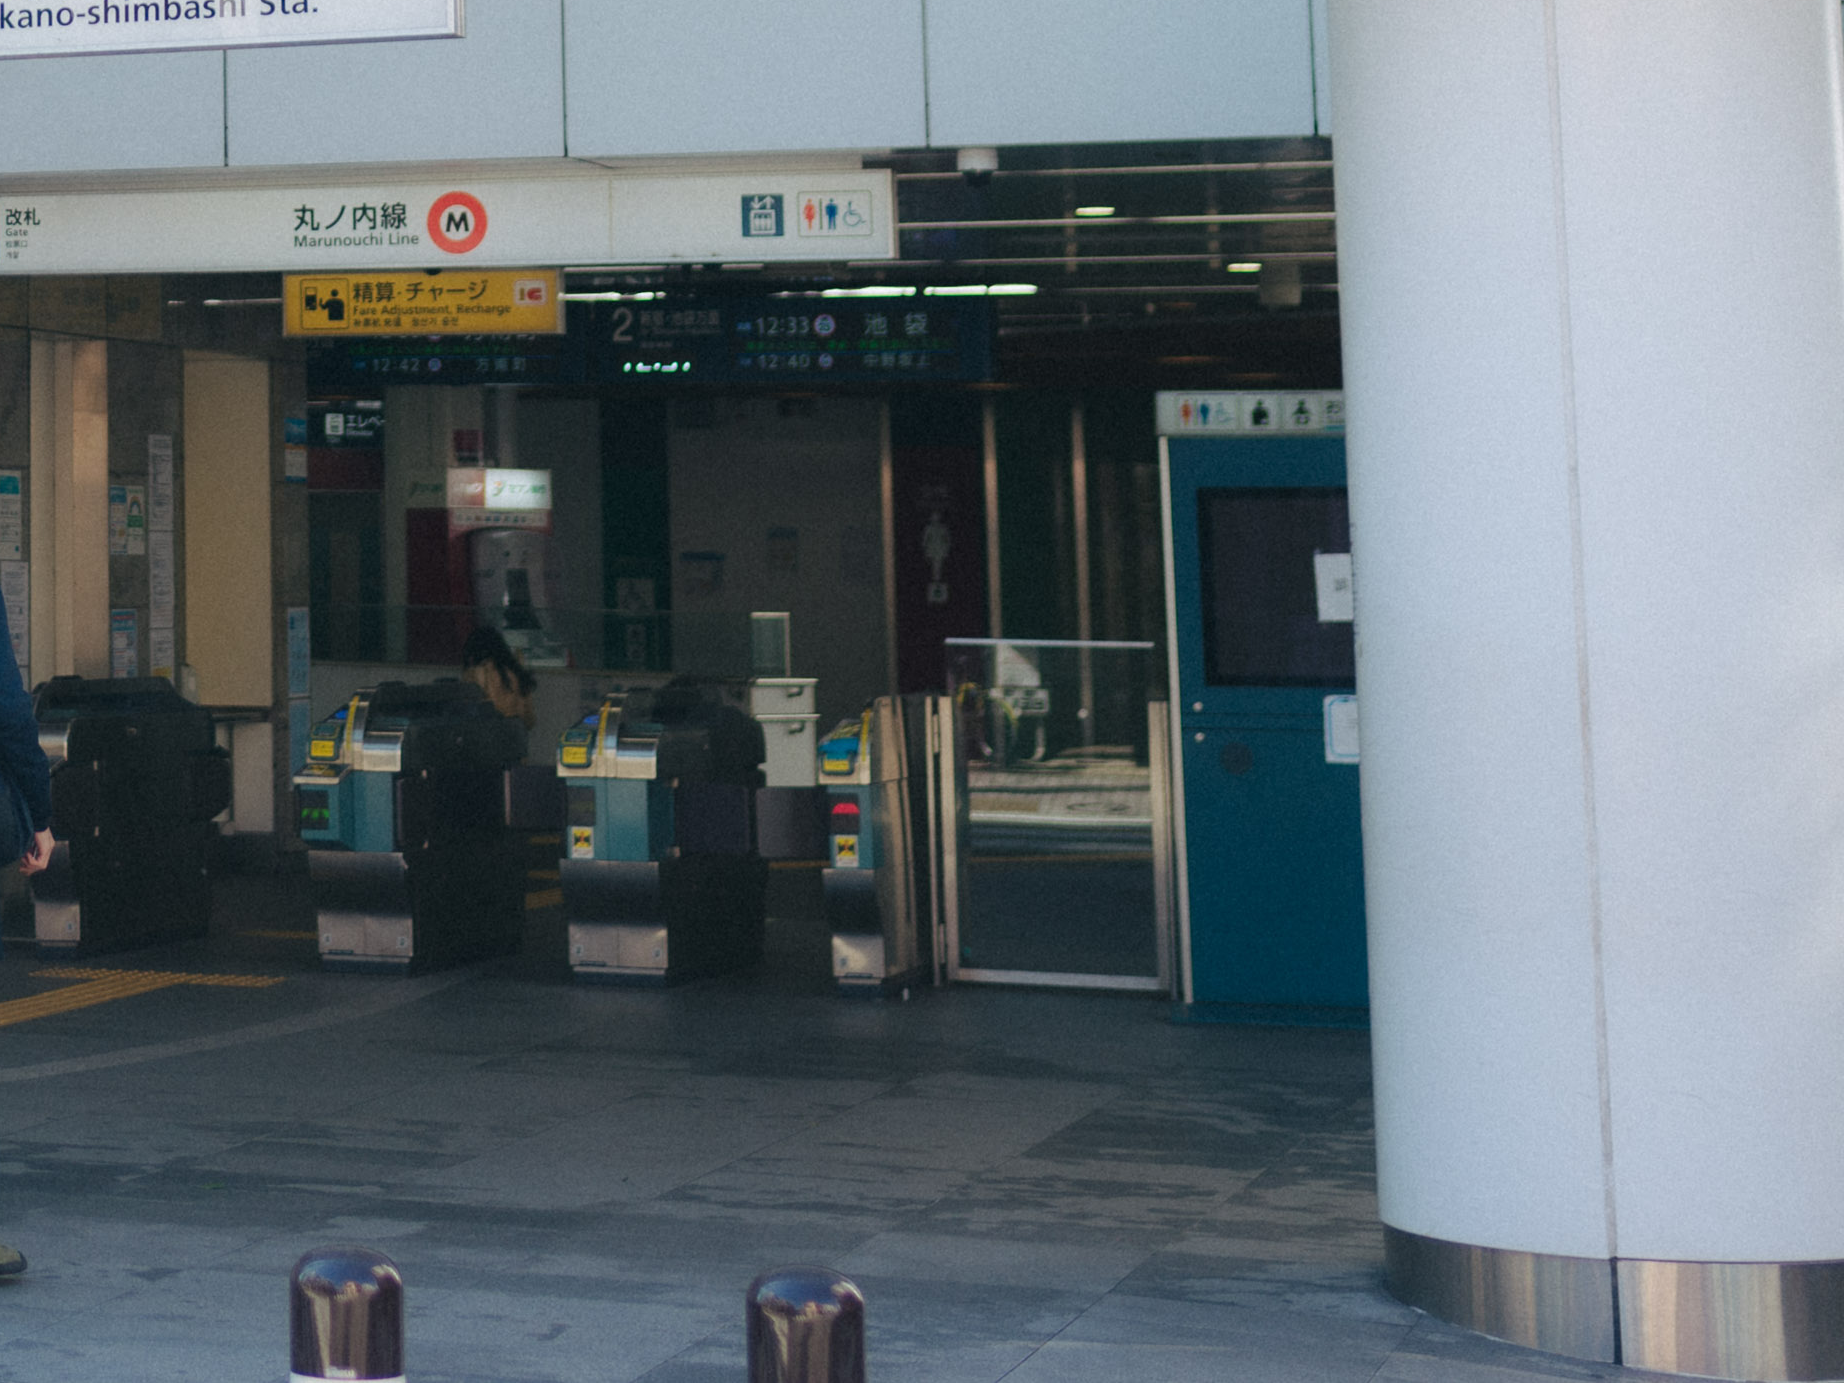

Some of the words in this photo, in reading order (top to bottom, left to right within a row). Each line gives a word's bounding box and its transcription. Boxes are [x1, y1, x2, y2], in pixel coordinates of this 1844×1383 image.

[5, 207, 41, 227] 改札
[293, 201, 409, 233] 丸ノ内線
[444, 212, 470, 233] M
[5, 228, 29, 237] Gate
[293, 233, 384, 248] Marunouchi
[388, 232, 420, 246] Line
[353, 305, 377, 316] Fare
[457, 304, 511, 317] Recharge
[612, 307, 633, 343] 2
[755, 316, 810, 335] 12:33
[371, 359, 420, 372] 12:42
